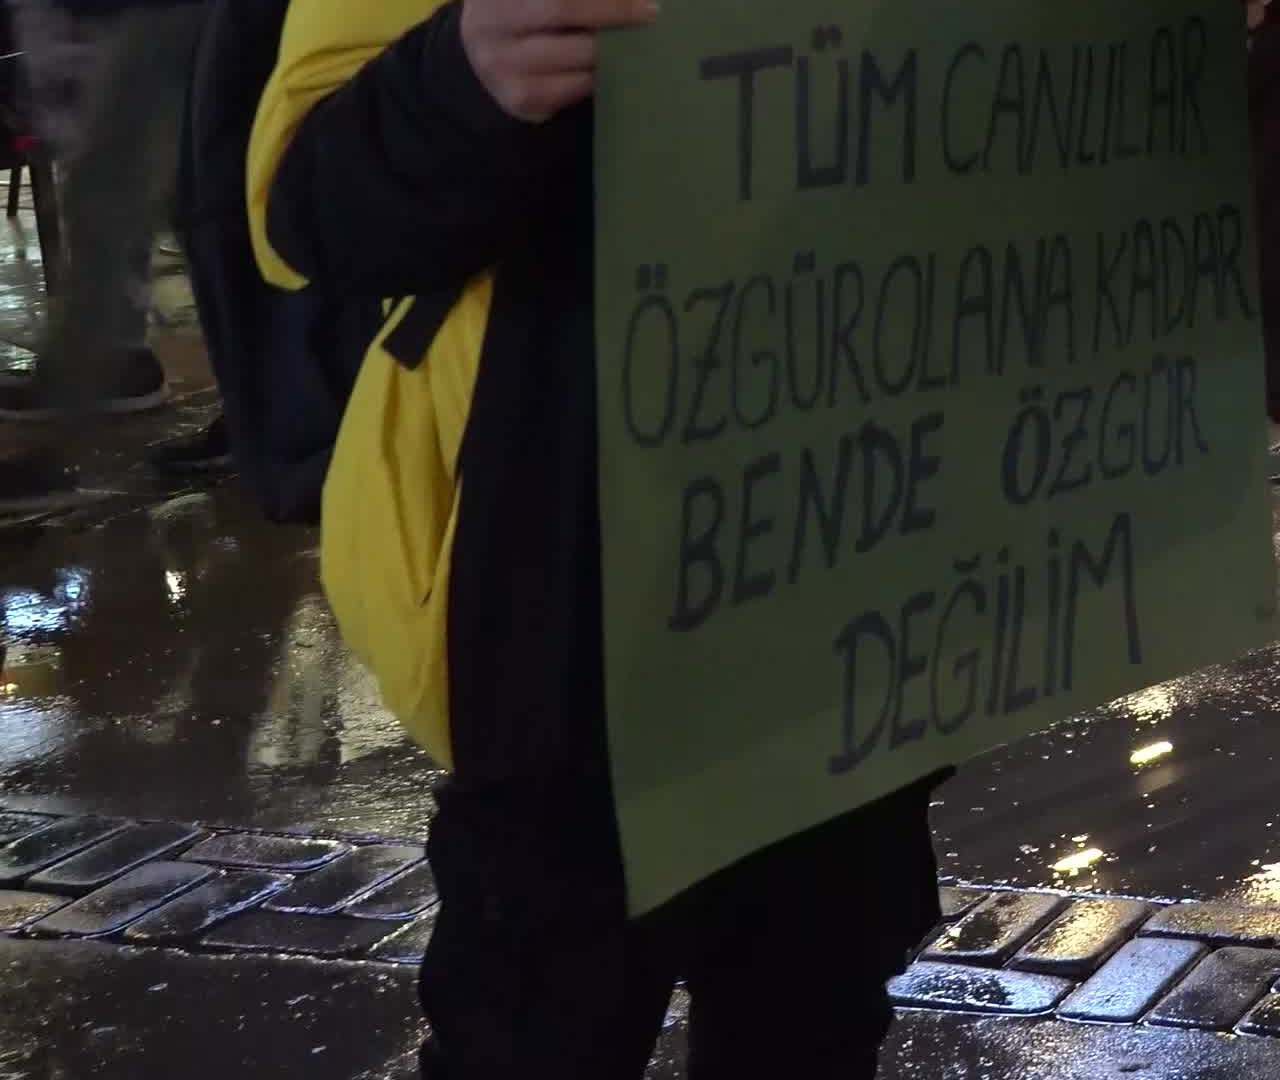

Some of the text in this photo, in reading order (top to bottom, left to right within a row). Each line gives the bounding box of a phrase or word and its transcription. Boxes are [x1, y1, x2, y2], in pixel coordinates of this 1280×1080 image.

[699, 16, 1208, 201] TÜM CANLILAR
[1091, 204, 1257, 354] KADAR
[667, 355, 1209, 633] BENDE ÖZGÜR
[828, 512, 1144, 776] DEĞİLİM
